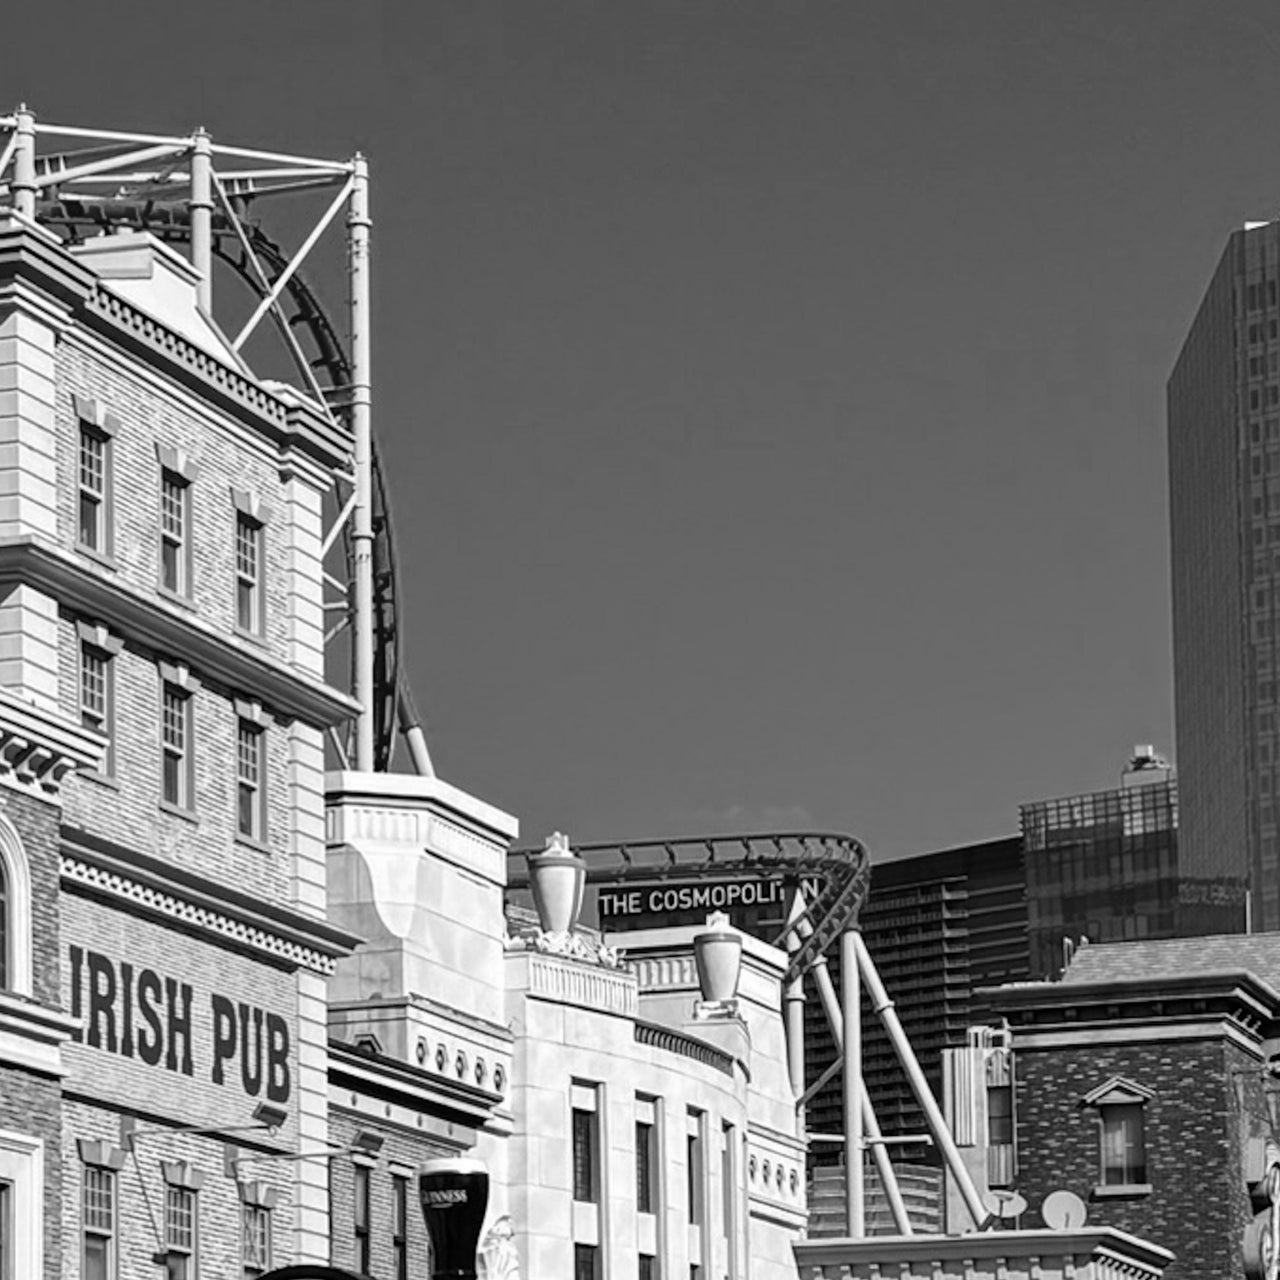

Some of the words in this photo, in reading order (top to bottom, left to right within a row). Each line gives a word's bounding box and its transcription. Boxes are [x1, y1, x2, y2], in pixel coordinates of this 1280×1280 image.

[599, 892, 642, 915] THE
[69, 944, 194, 1077] IRISH
[211, 993, 290, 1103] PUB
